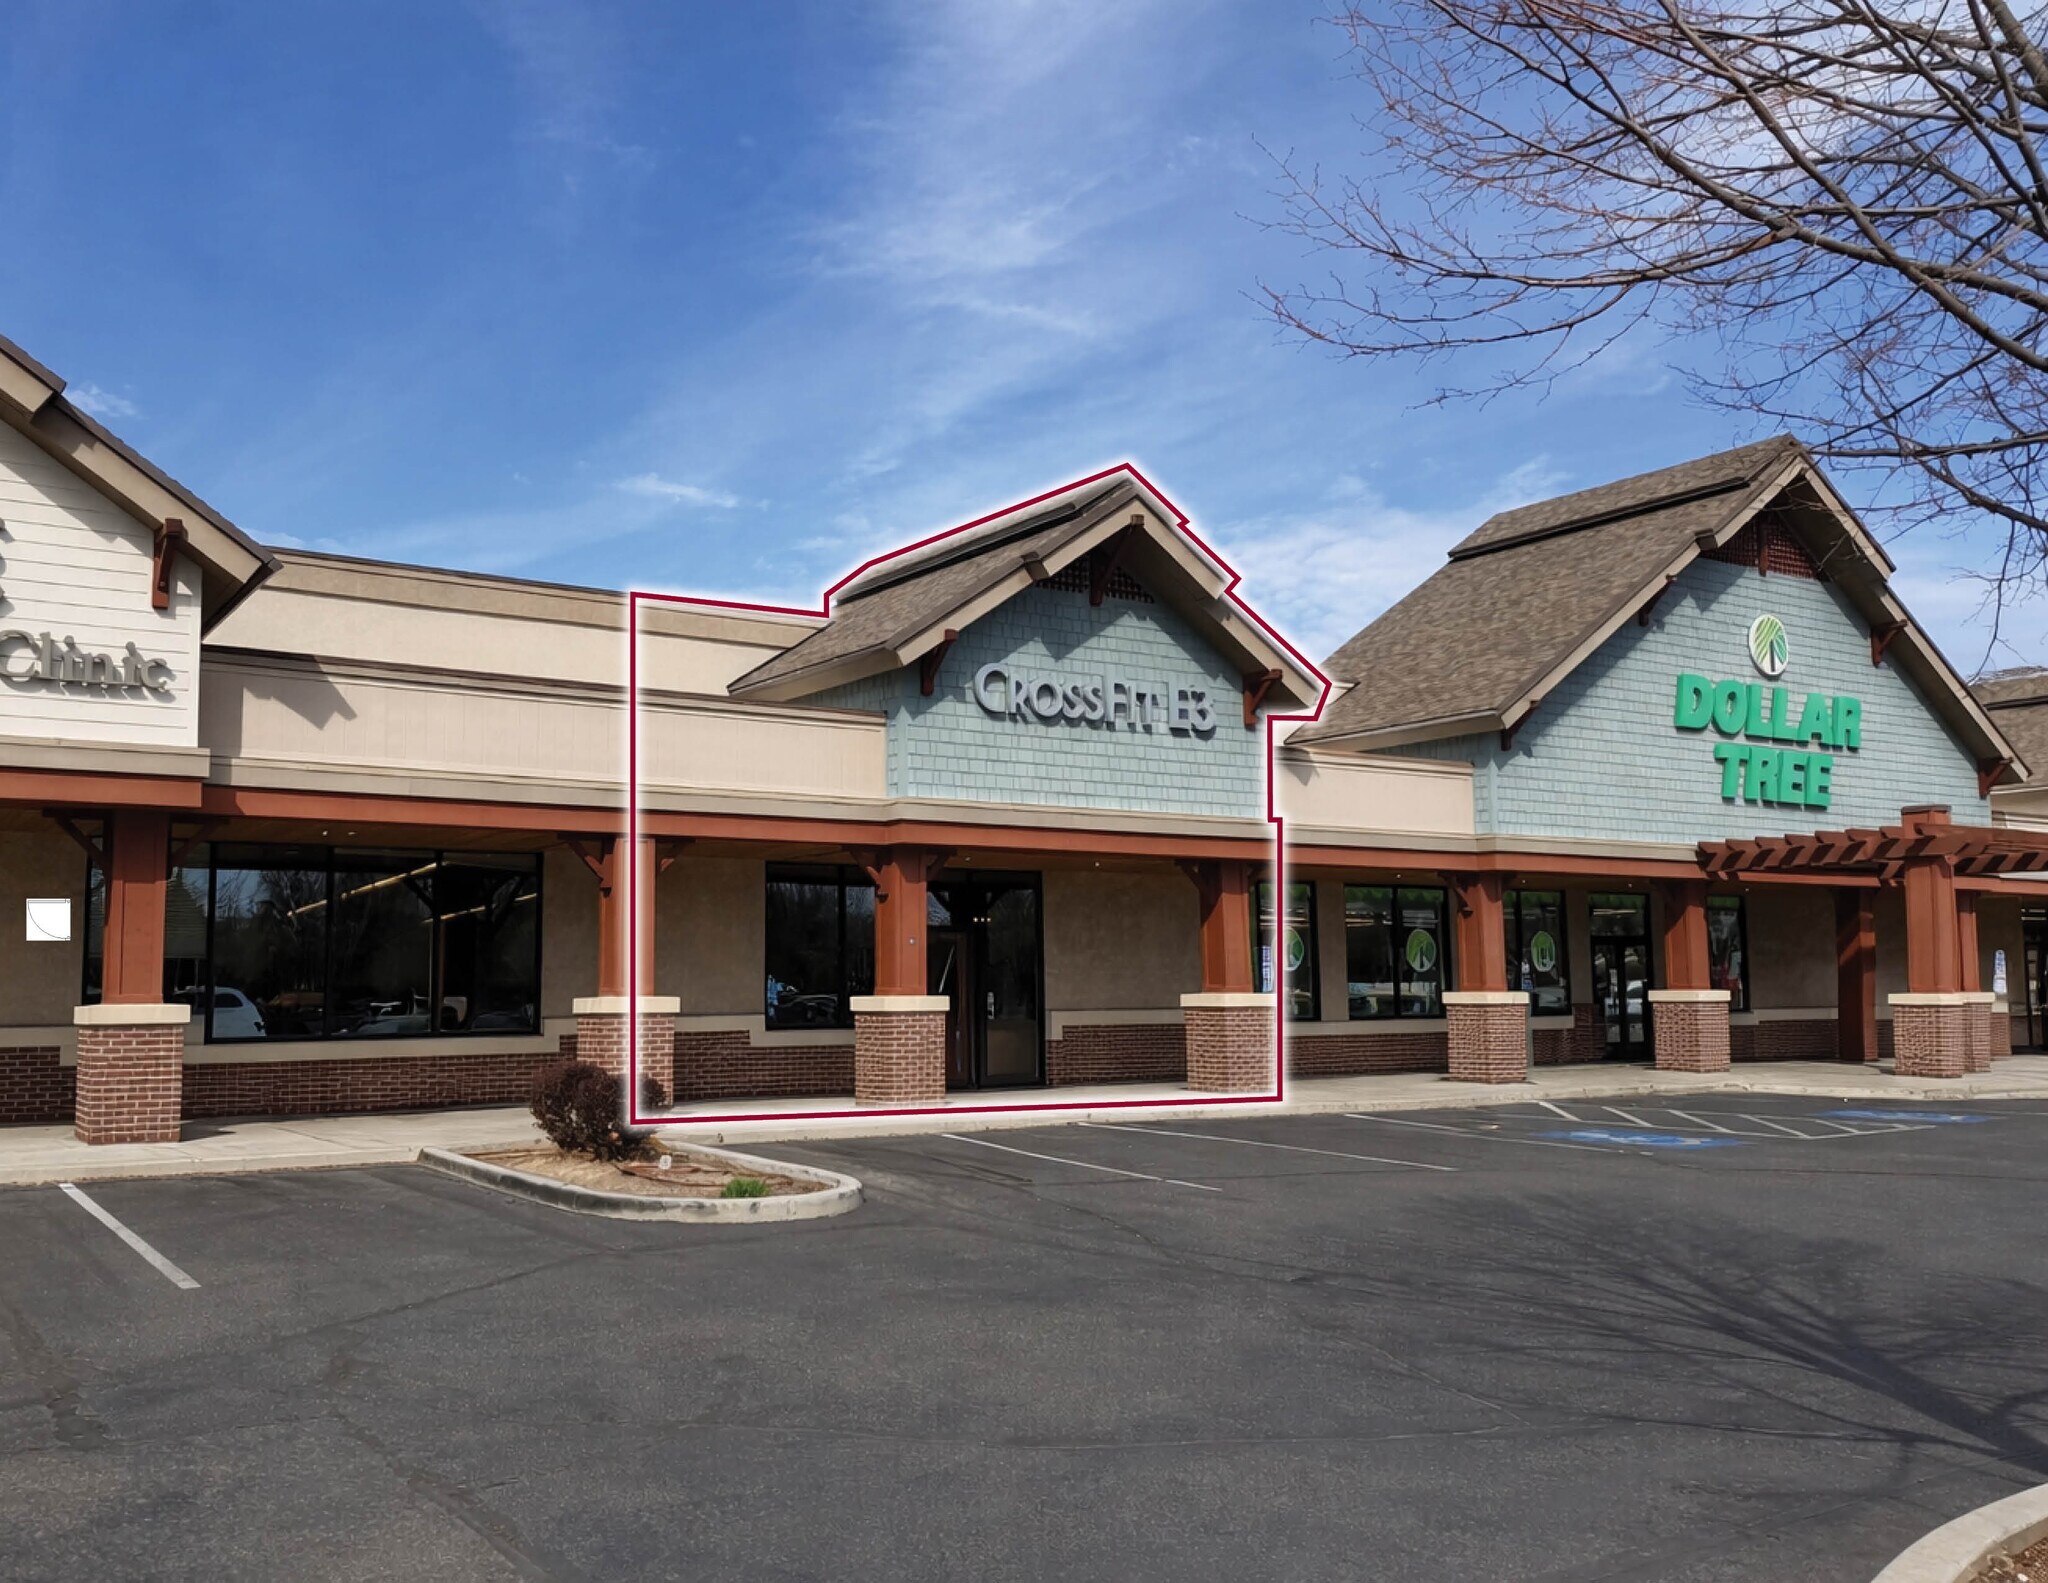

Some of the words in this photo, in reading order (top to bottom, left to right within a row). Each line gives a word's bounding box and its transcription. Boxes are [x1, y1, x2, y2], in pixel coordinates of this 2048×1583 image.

[0, 629, 169, 691] Clinic
[1167, 681, 1216, 734] E3
[1674, 673, 1861, 750] DOLLAR
[1714, 742, 1833, 809] TREE
